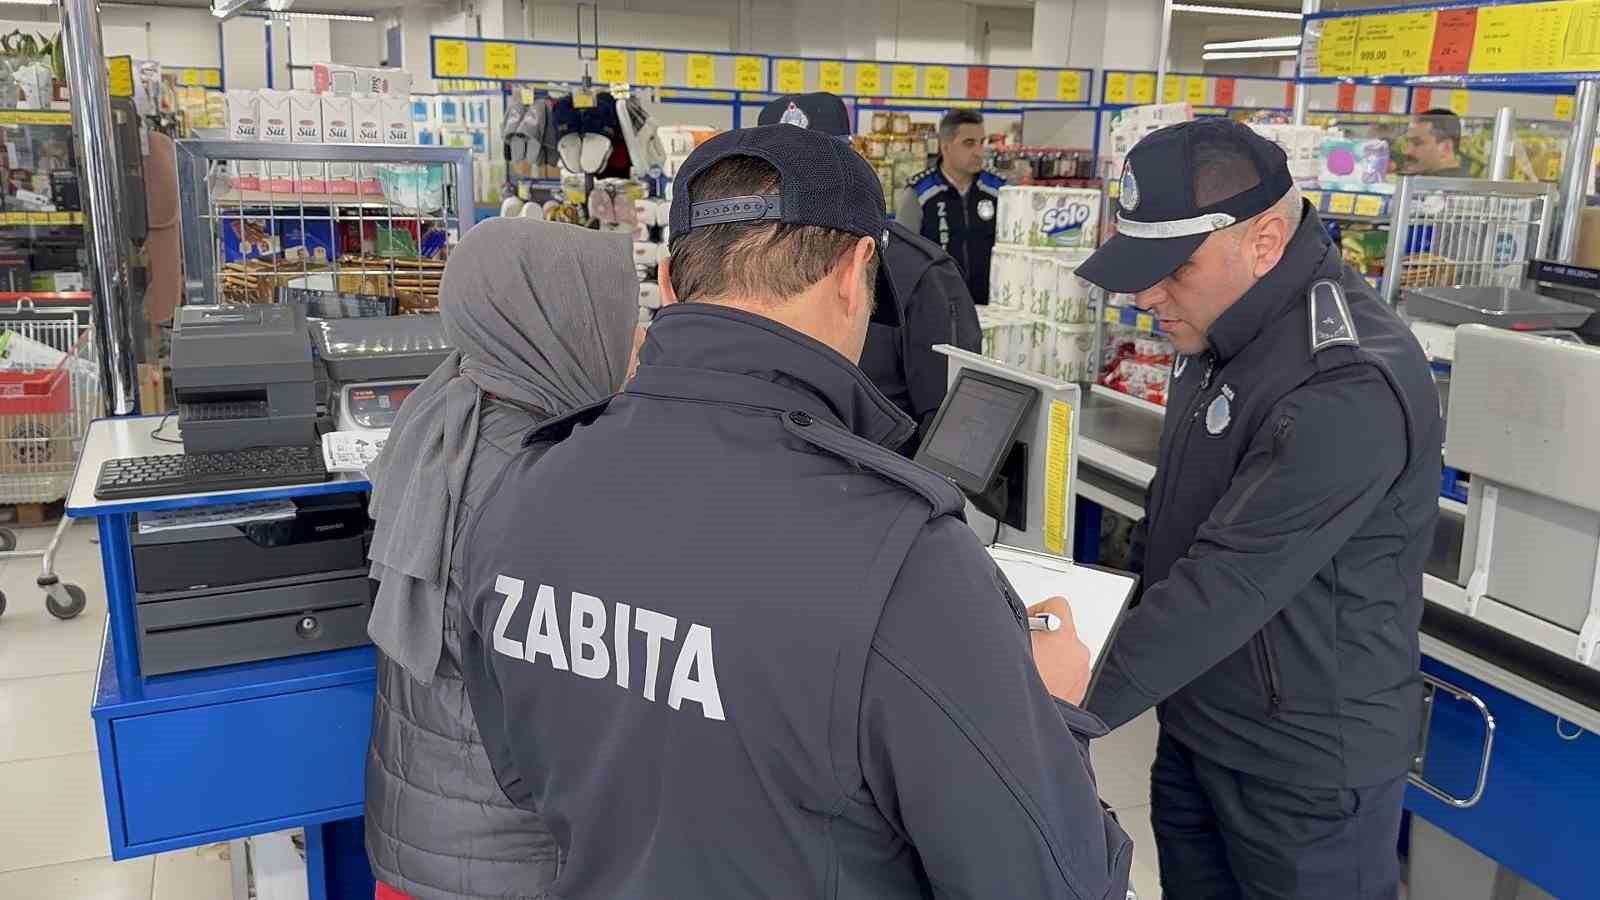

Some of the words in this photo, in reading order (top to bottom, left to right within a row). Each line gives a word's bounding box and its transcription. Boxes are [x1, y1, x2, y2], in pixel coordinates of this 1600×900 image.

[236, 124, 255, 136] Süt
[266, 125, 285, 137] Süt
[297, 126, 316, 137] Süt
[328, 127, 347, 138] Süt
[389, 129, 408, 140] Süt
[1042, 203, 1089, 231] Solo
[493, 574, 726, 721] ZABITA
